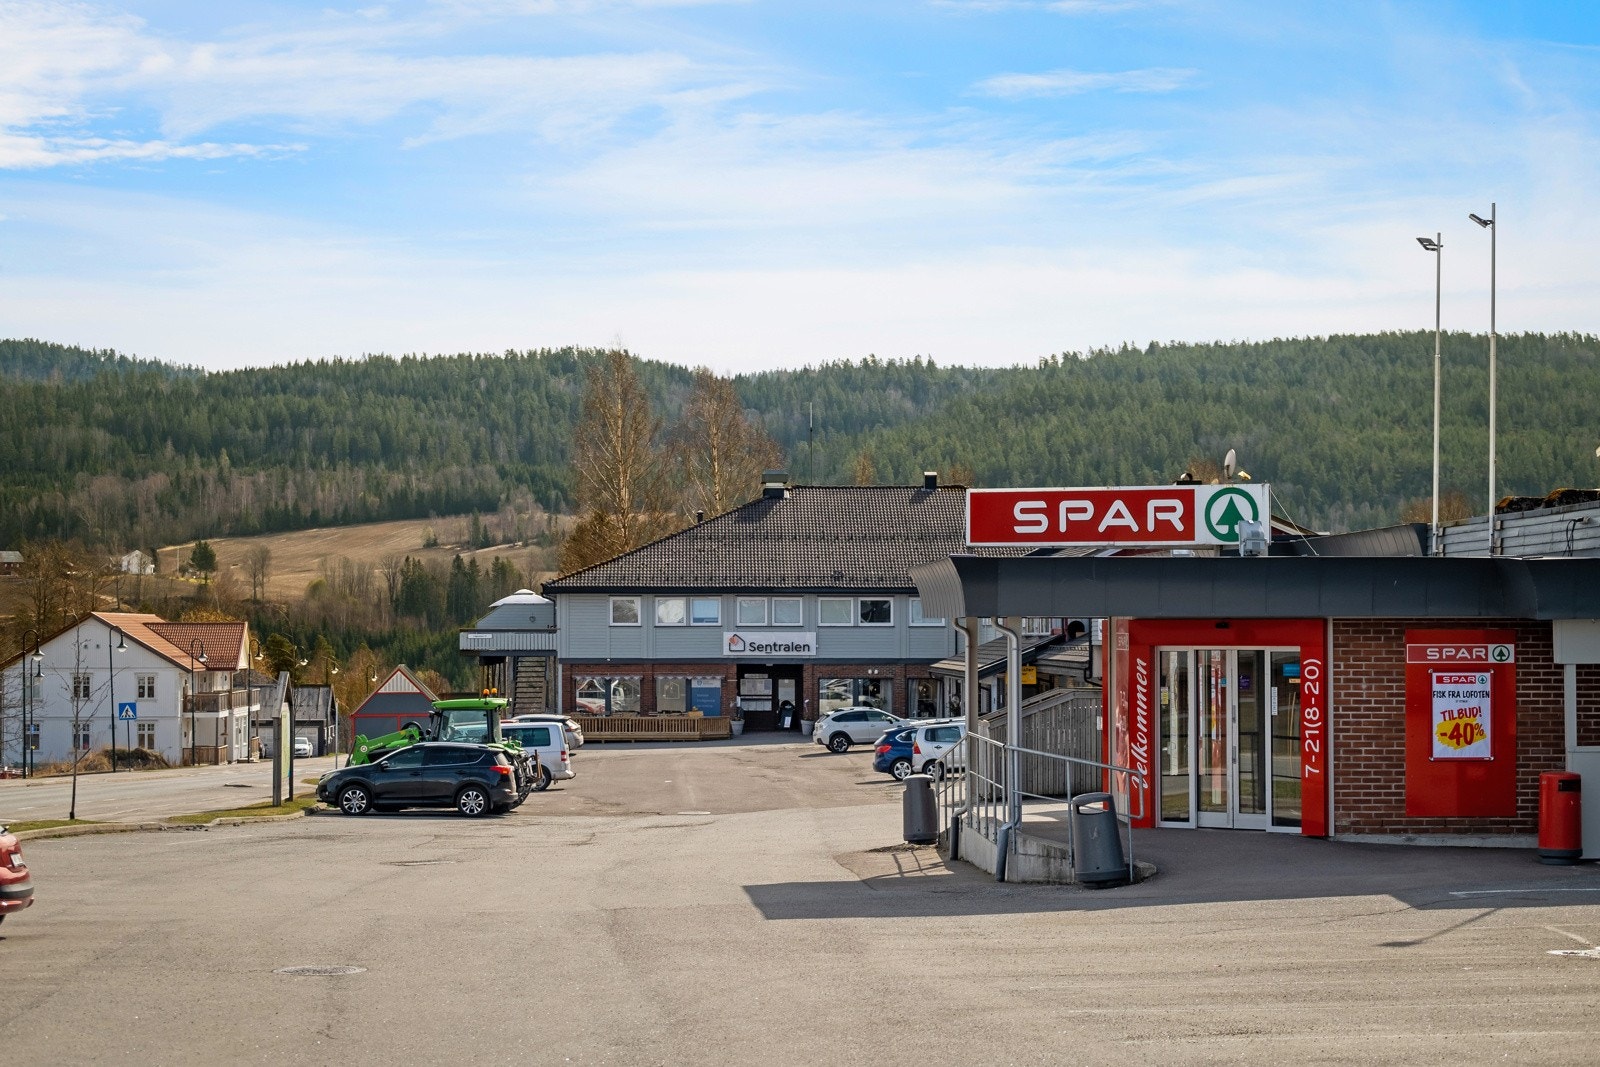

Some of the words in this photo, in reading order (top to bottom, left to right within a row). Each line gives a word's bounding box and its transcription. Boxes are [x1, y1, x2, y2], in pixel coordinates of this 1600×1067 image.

[1013, 499, 1185, 533] SPAR
[749, 642, 810, 654] Sentralen
[1426, 648, 1486, 660] SPAR
[1432, 690, 1447, 699] FISK
[1448, 690, 1461, 699] FRA
[1462, 690, 1490, 699] LOFOTEN
[1440, 706, 1483, 721] TILBUD!
[1131, 658, 1149, 789] Velkommen
[1440, 722, 1485, 747] -40%
